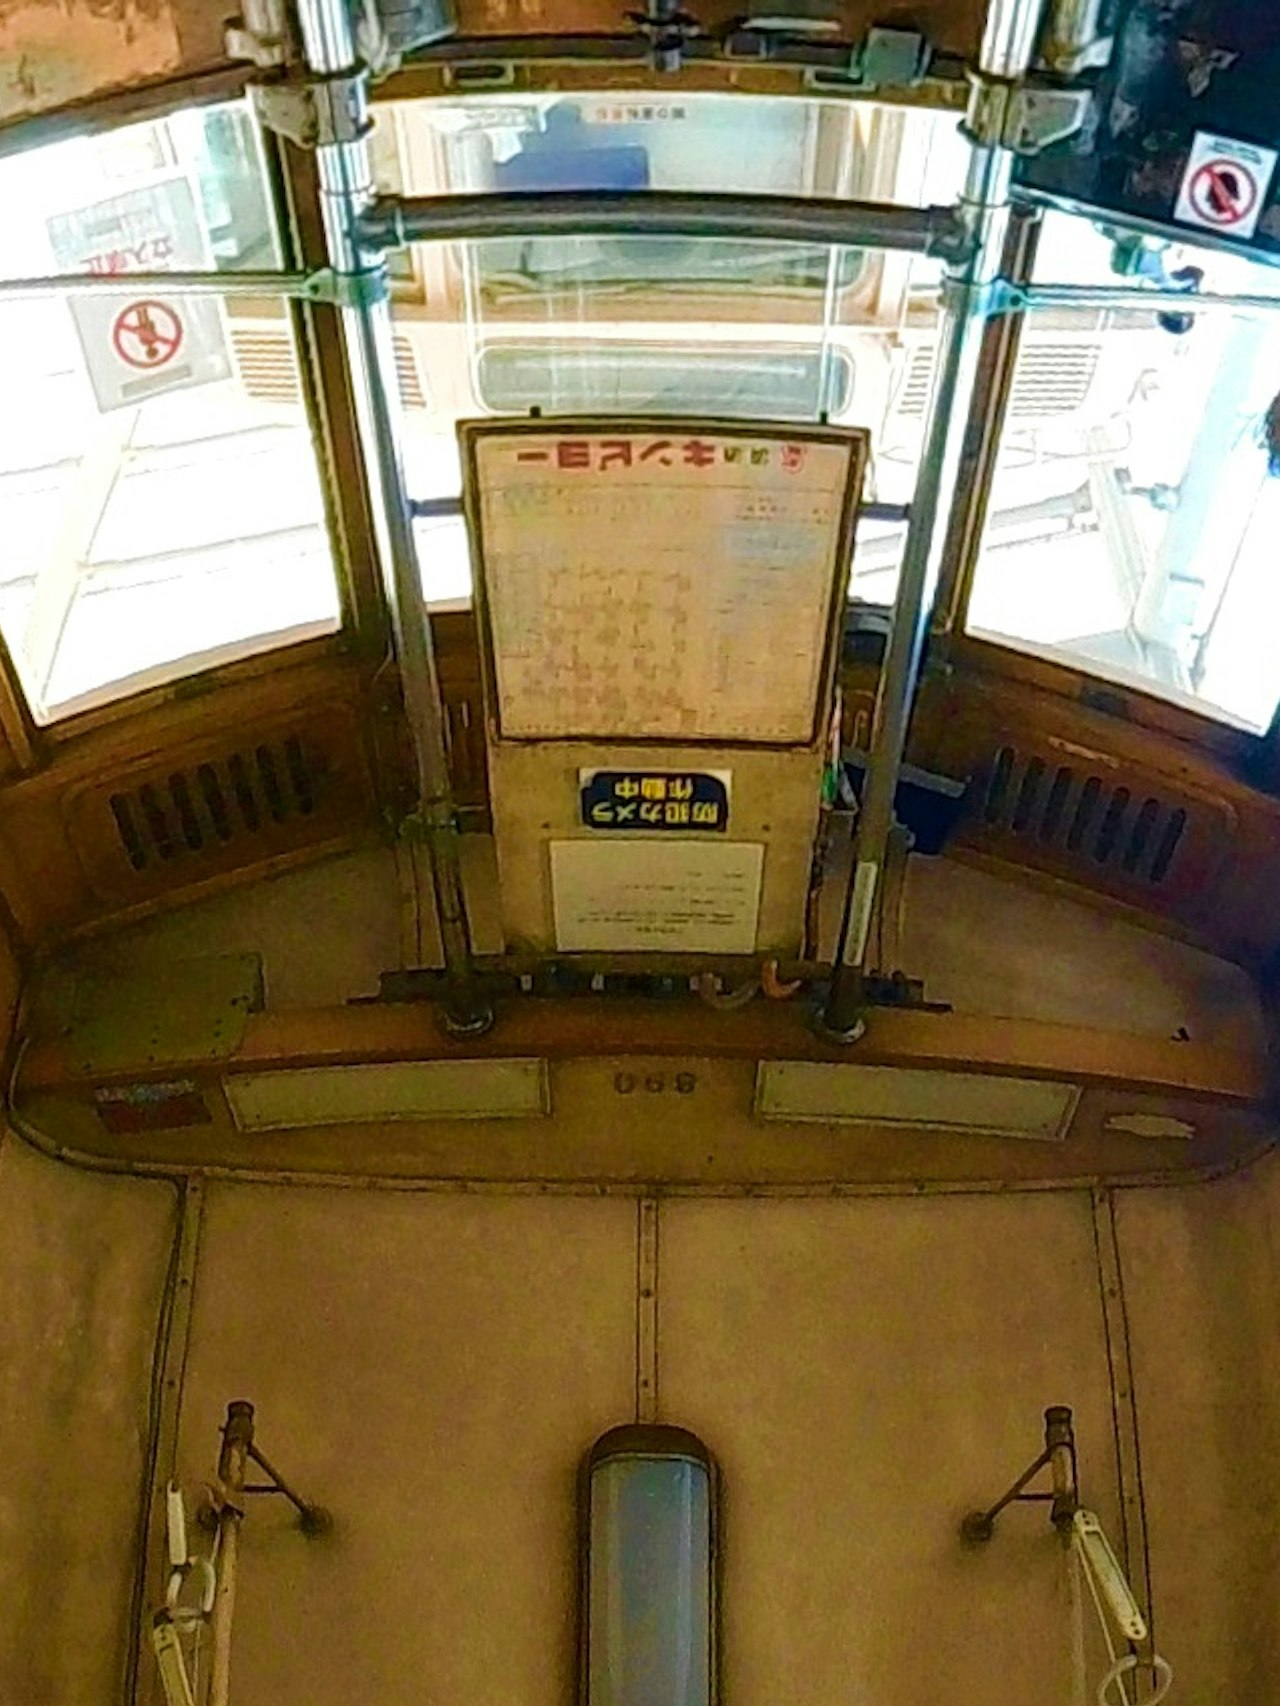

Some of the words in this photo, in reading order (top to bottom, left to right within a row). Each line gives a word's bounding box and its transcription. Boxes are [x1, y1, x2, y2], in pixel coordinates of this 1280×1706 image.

[614, 777, 694, 800] 作動中
[590, 801, 720, 824] 防犯カメラ
